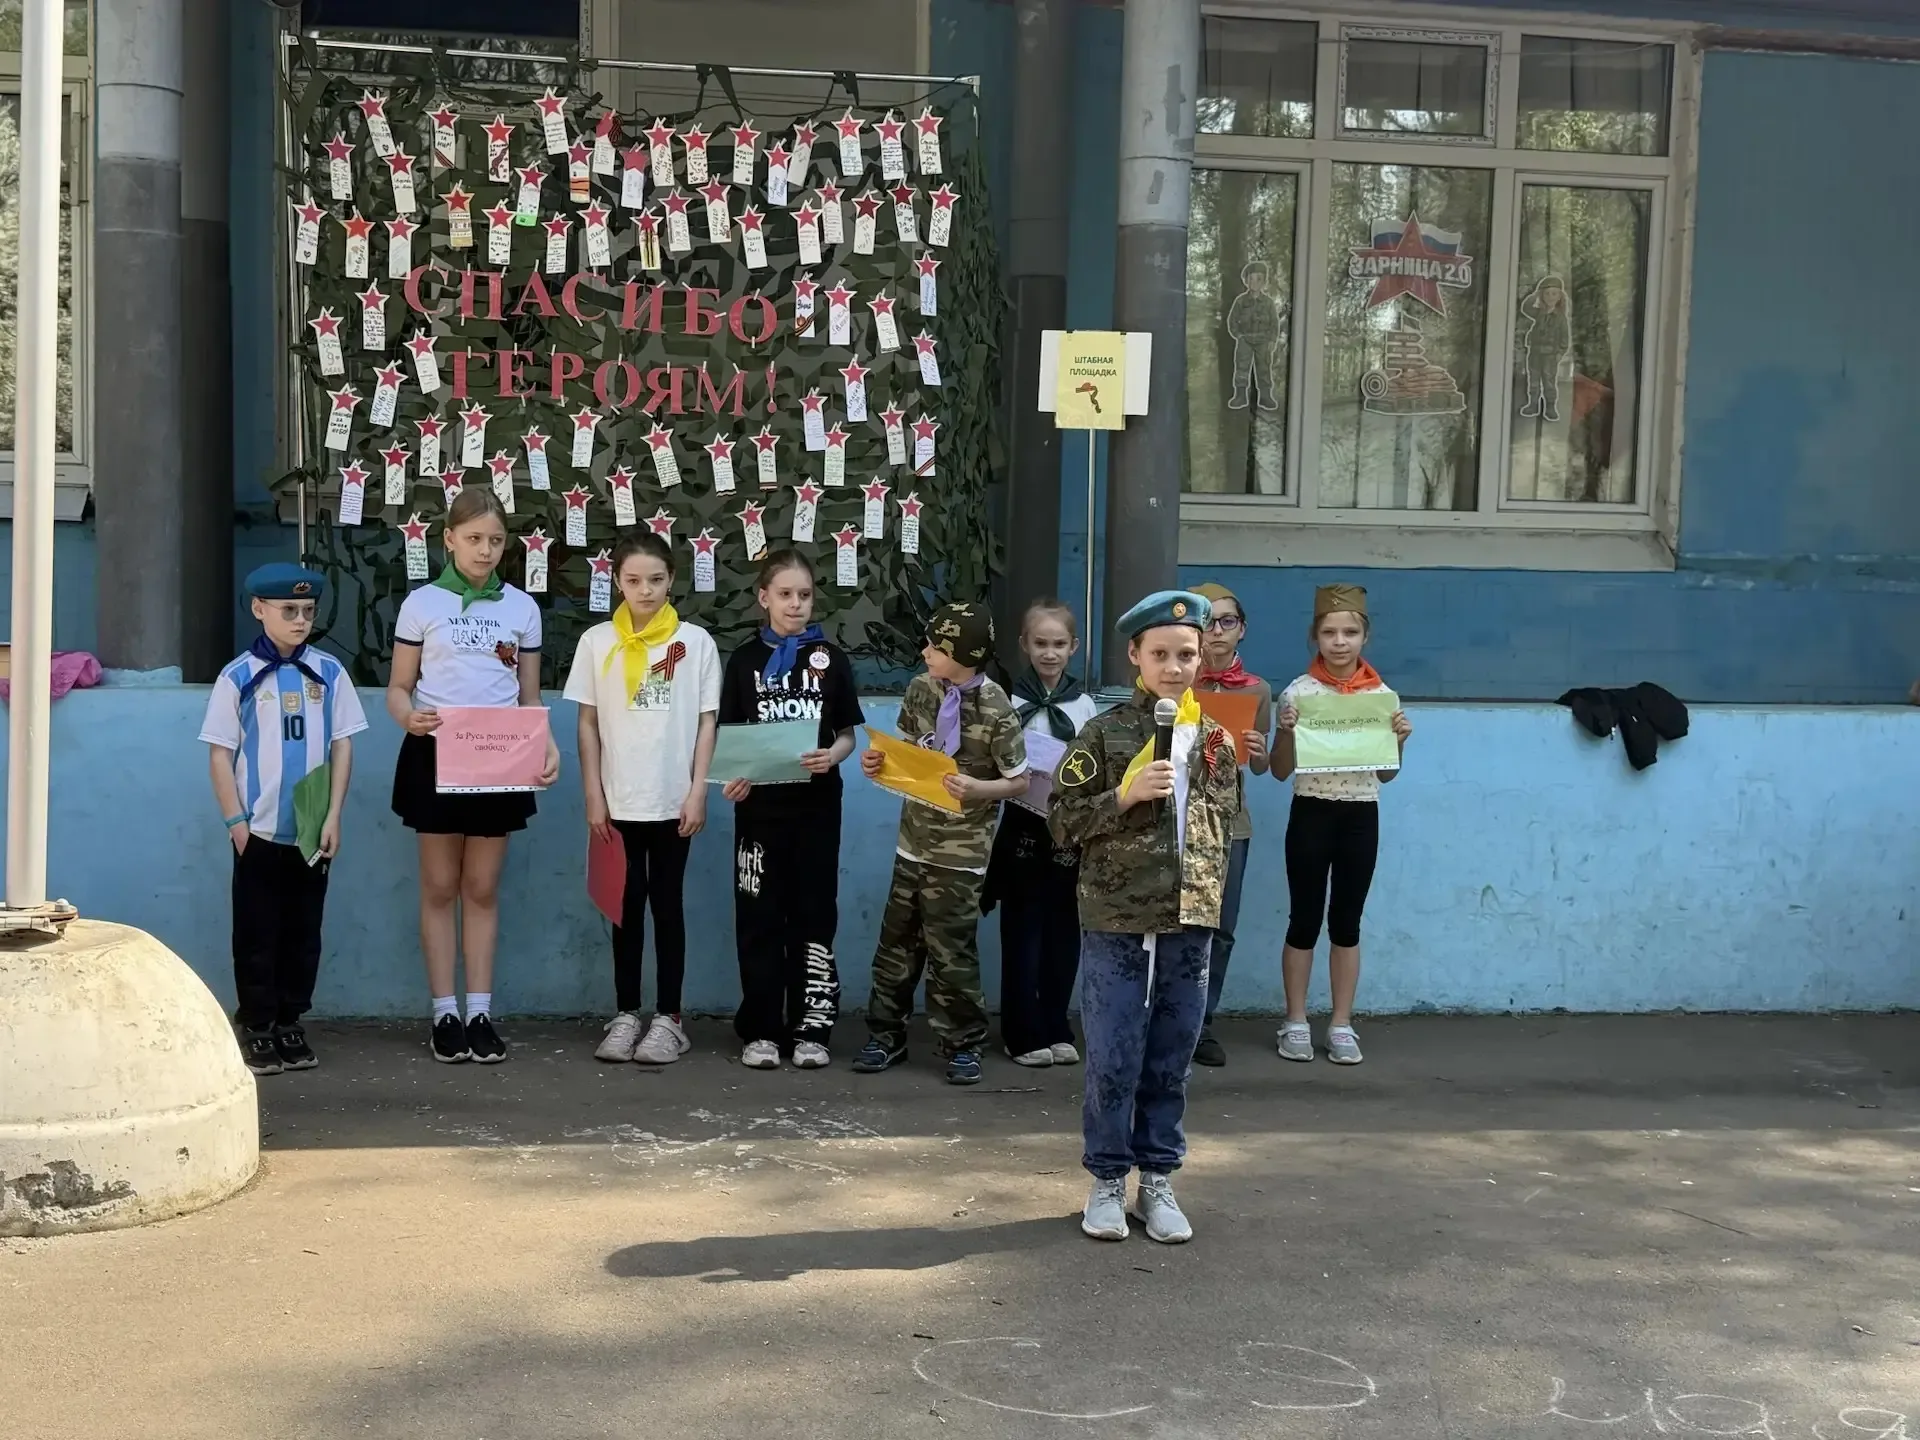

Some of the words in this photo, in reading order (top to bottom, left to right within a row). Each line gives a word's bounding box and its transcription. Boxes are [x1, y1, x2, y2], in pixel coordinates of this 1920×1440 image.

[1351, 256, 1443, 279] ЗАРНИЦА
[403, 264, 778, 344] СПАСИБО
[1074, 356, 1114, 364] ШТАБНАЯ
[450, 350, 778, 417] ГЕРОЯМ!
[1069, 368, 1117, 377] ПЛОЩАДКА
[448, 617, 470, 626] NEW
[474, 618, 501, 628] YORK
[754, 668, 792, 693] LET
[757, 698, 824, 721] SNOW
[283, 715, 305, 741] 10
[455, 732, 464, 740] За
[465, 732, 485, 742] Русь
